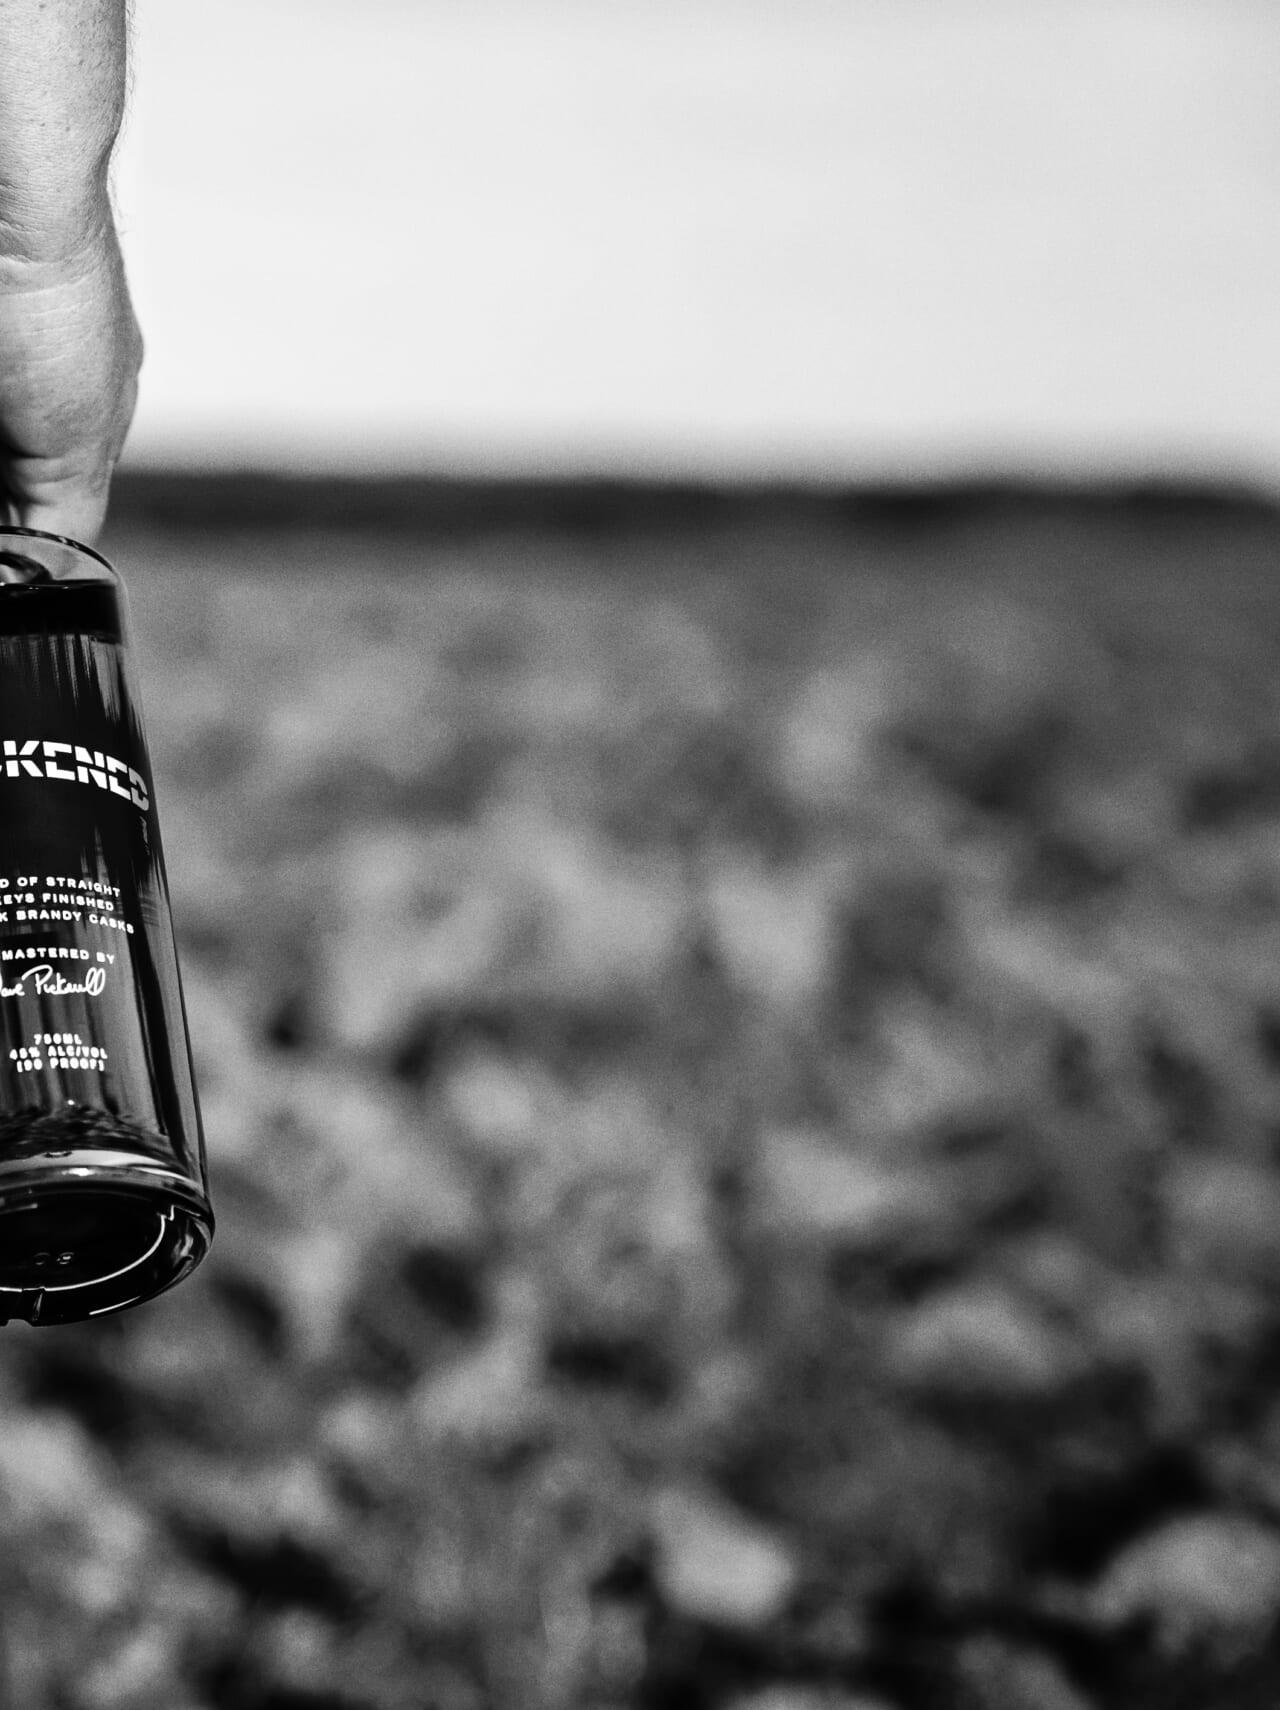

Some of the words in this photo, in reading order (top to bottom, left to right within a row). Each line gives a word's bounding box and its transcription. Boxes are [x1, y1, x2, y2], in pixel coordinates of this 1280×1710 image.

[17, 876, 39, 887] OF
[46, 876, 121, 898] STRAIGHT
[42, 893, 114, 912] FINISHED
[16, 909, 82, 922] BRANDY
[89, 913, 135, 934] CASKS
[96, 951, 115, 965] BY
